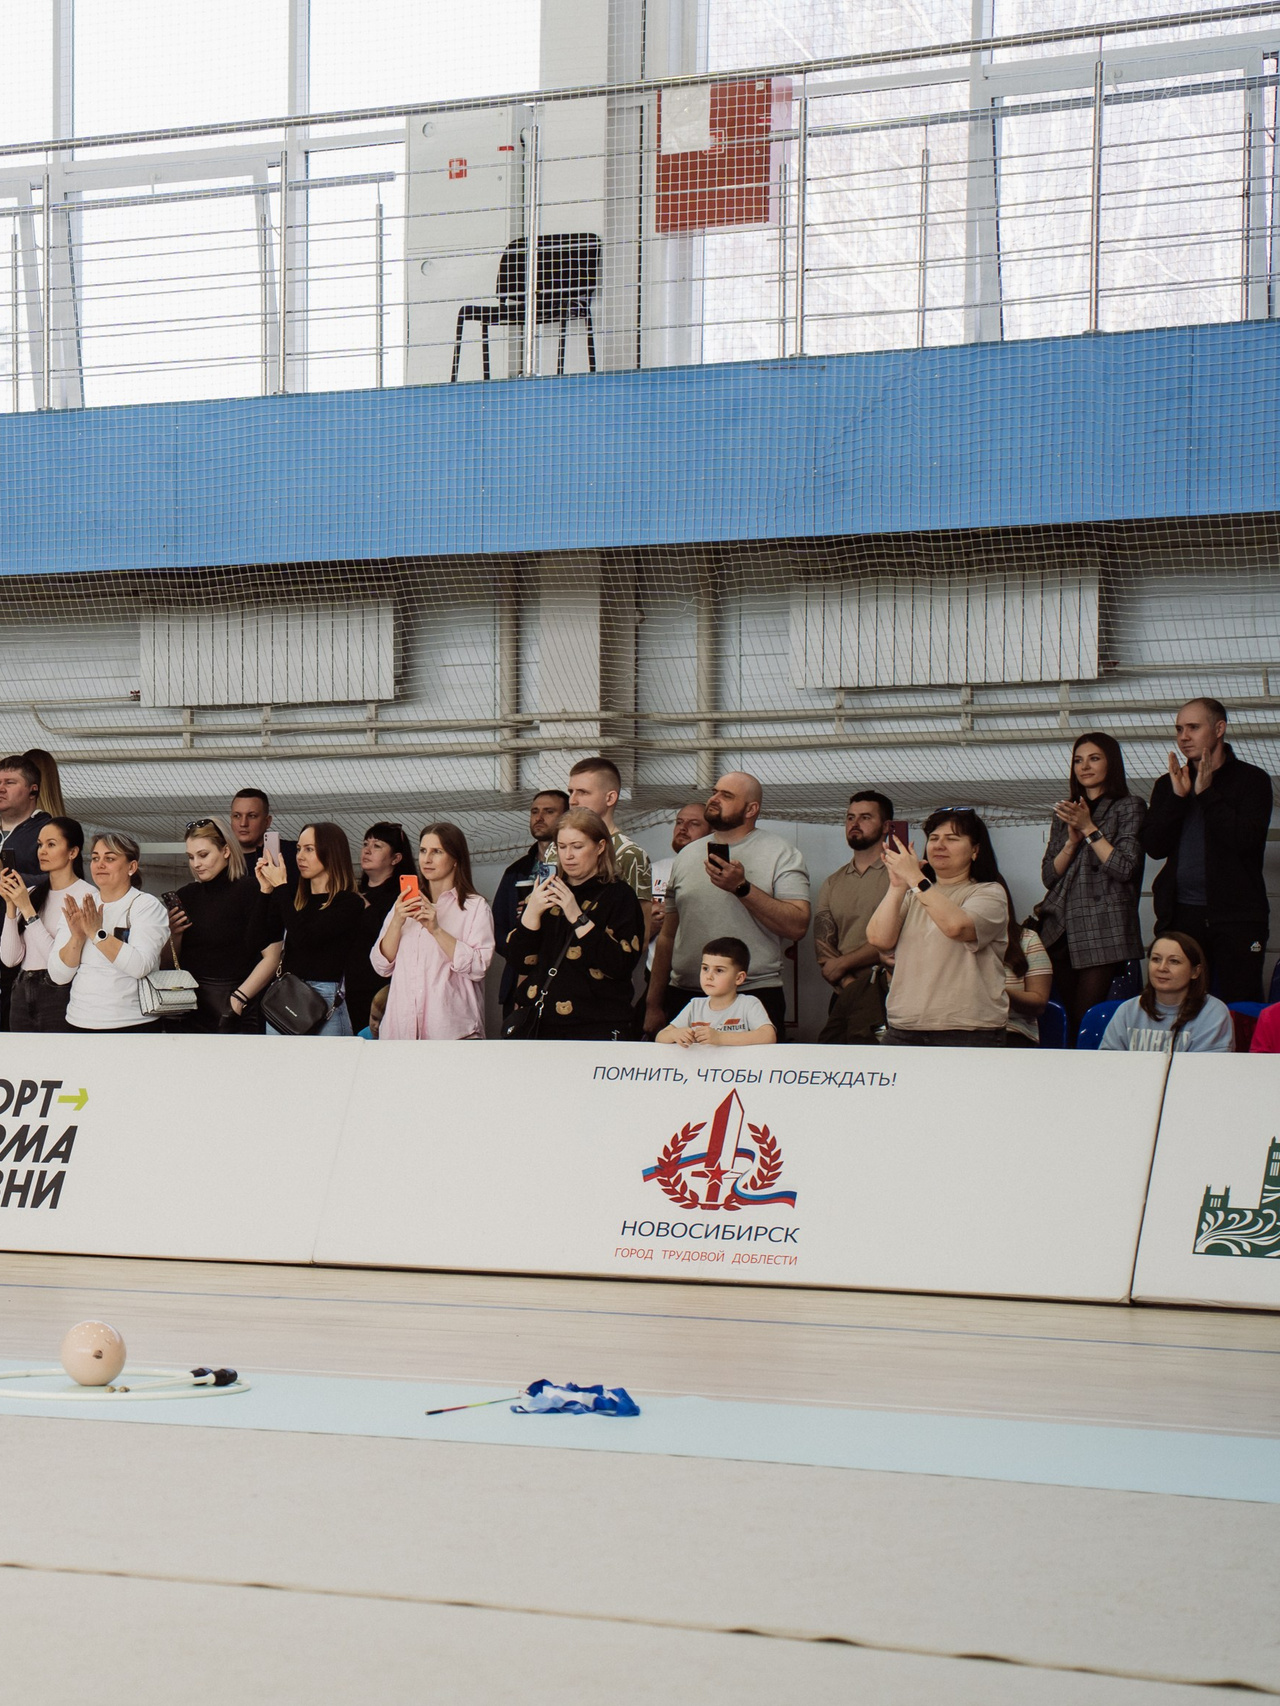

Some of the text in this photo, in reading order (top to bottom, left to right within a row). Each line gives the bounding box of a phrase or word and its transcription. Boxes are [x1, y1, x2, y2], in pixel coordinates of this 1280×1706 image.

[592, 1066, 897, 1088] ПОМНИТЬ, ЧТОБЫ ПОБЕЖДАТЬ!
[621, 1220, 800, 1244] НОВОСИБИРСК
[614, 1247, 798, 1266] ГОРОД ТРУДОВОЙ ДОБЛЕСТИ
